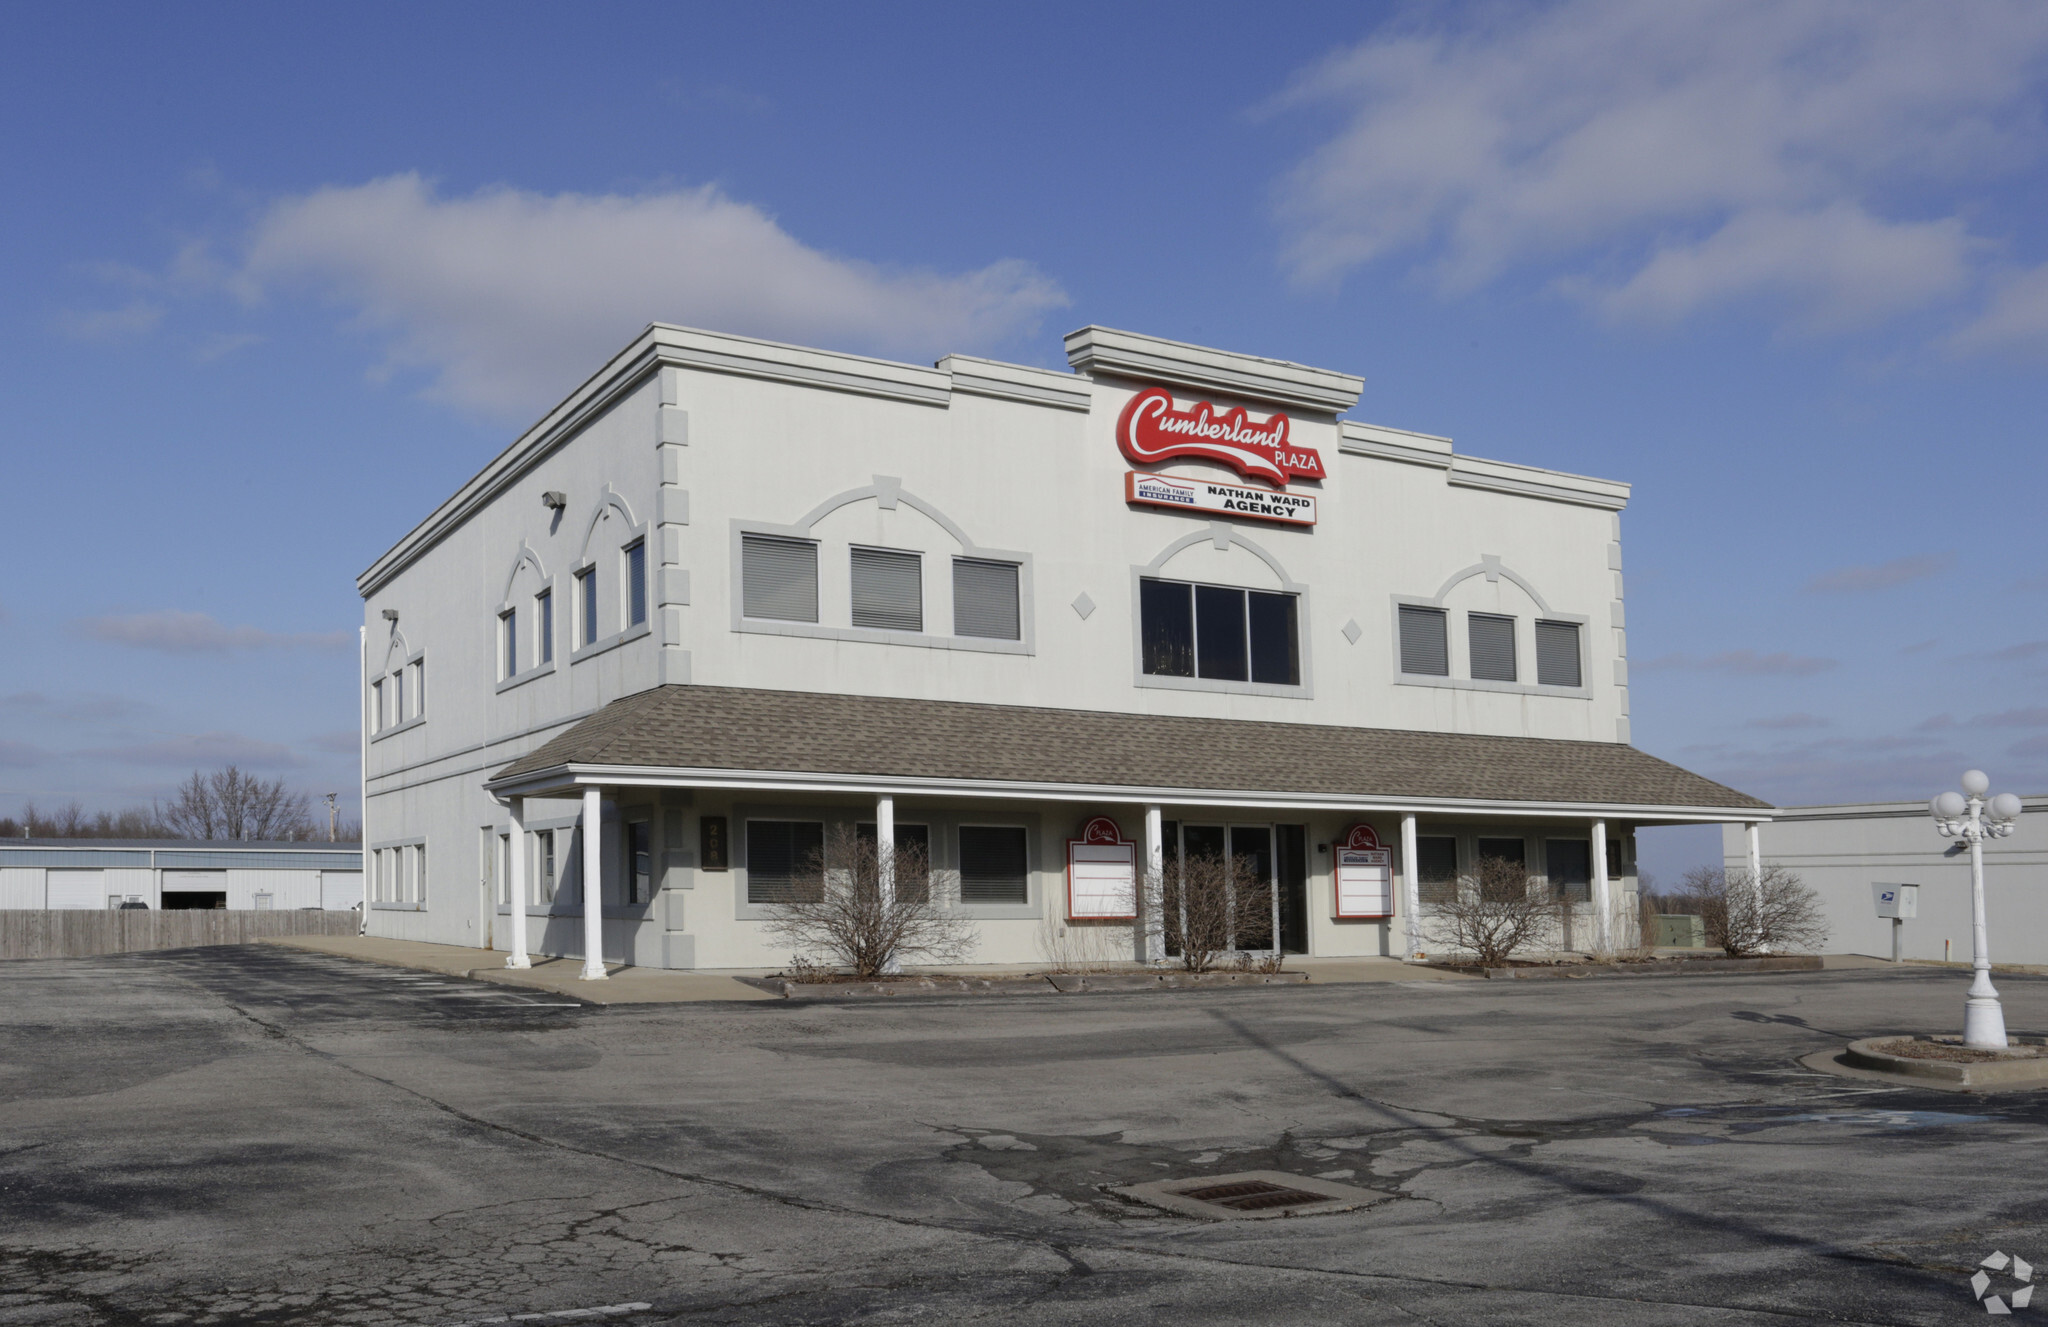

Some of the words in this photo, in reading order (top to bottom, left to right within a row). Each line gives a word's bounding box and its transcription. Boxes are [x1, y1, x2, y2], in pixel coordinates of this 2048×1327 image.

[1129, 396, 1283, 455] Cumberland
[1275, 451, 1317, 471] PLAZA
[1139, 484, 1170, 493] AMERICAN
[1143, 491, 1190, 502] INSURANCE
[1208, 486, 1264, 501] NATHAN
[1271, 495, 1310, 508] WARD
[1224, 498, 1295, 517] AGENCY
